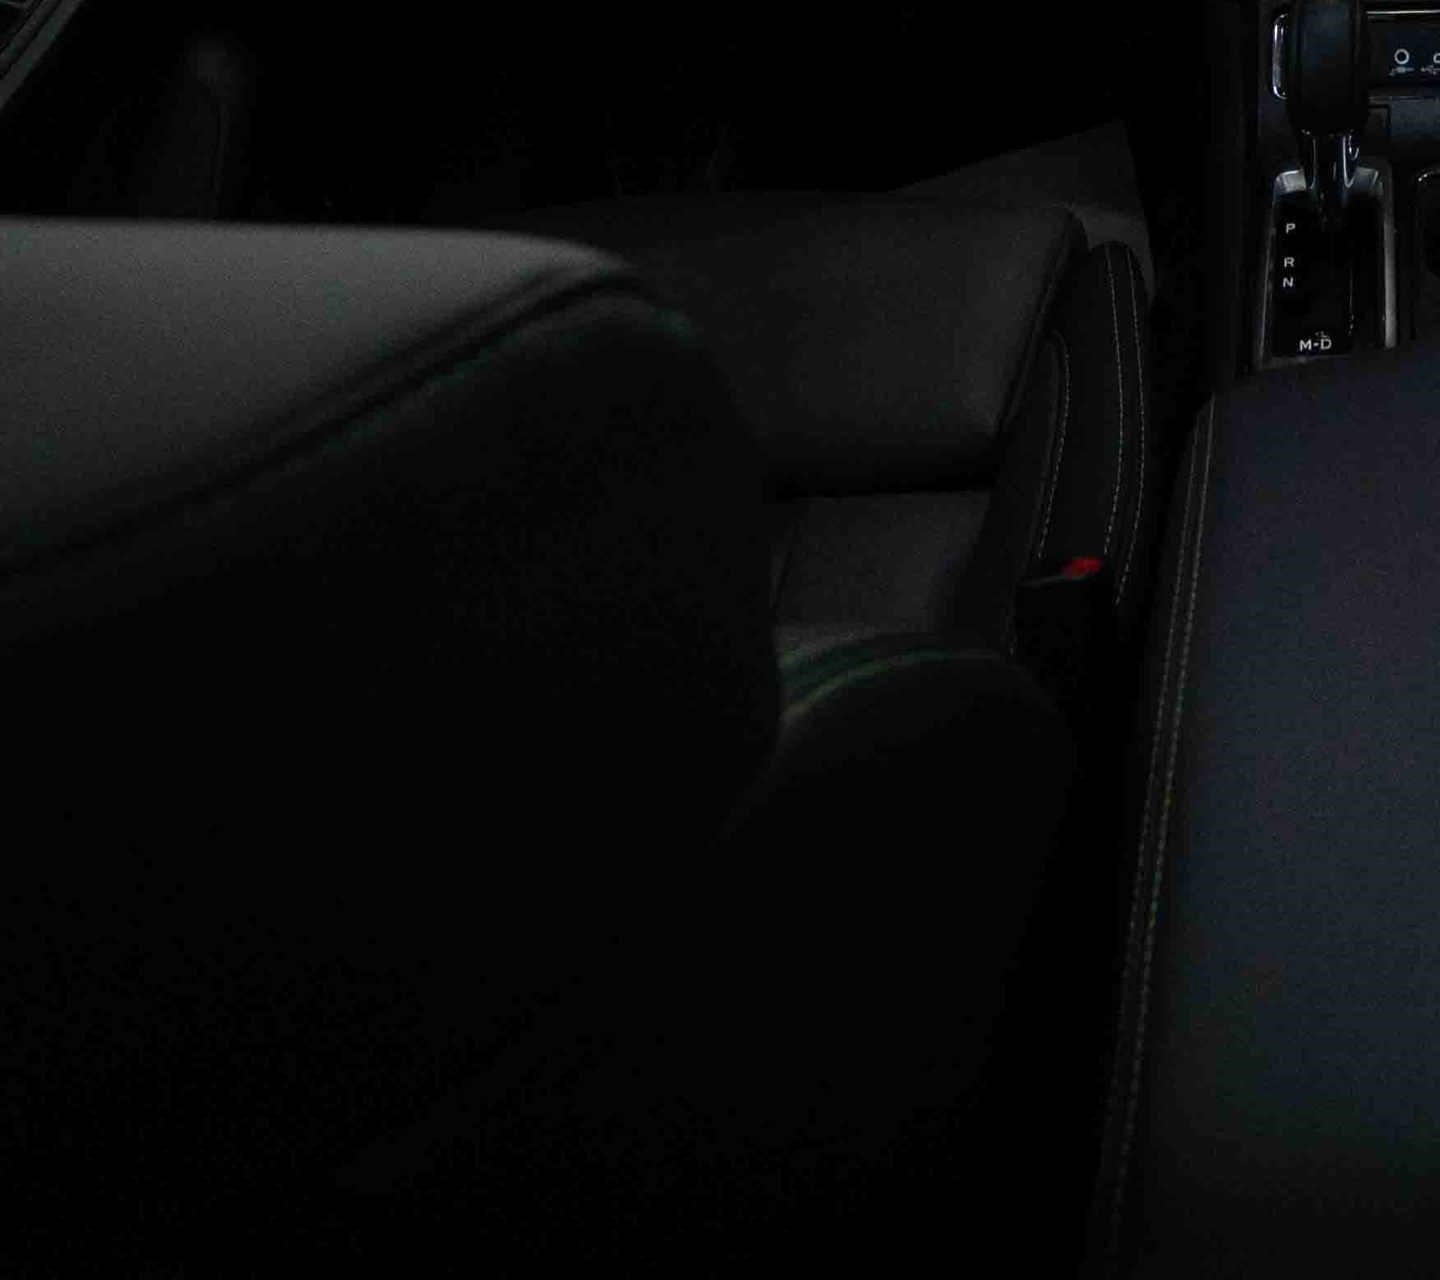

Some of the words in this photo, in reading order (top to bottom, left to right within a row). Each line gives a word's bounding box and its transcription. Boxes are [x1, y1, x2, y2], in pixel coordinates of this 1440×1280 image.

[1285, 222, 1296, 235] P
[1283, 256, 1296, 268] R
[1282, 276, 1294, 288] N
